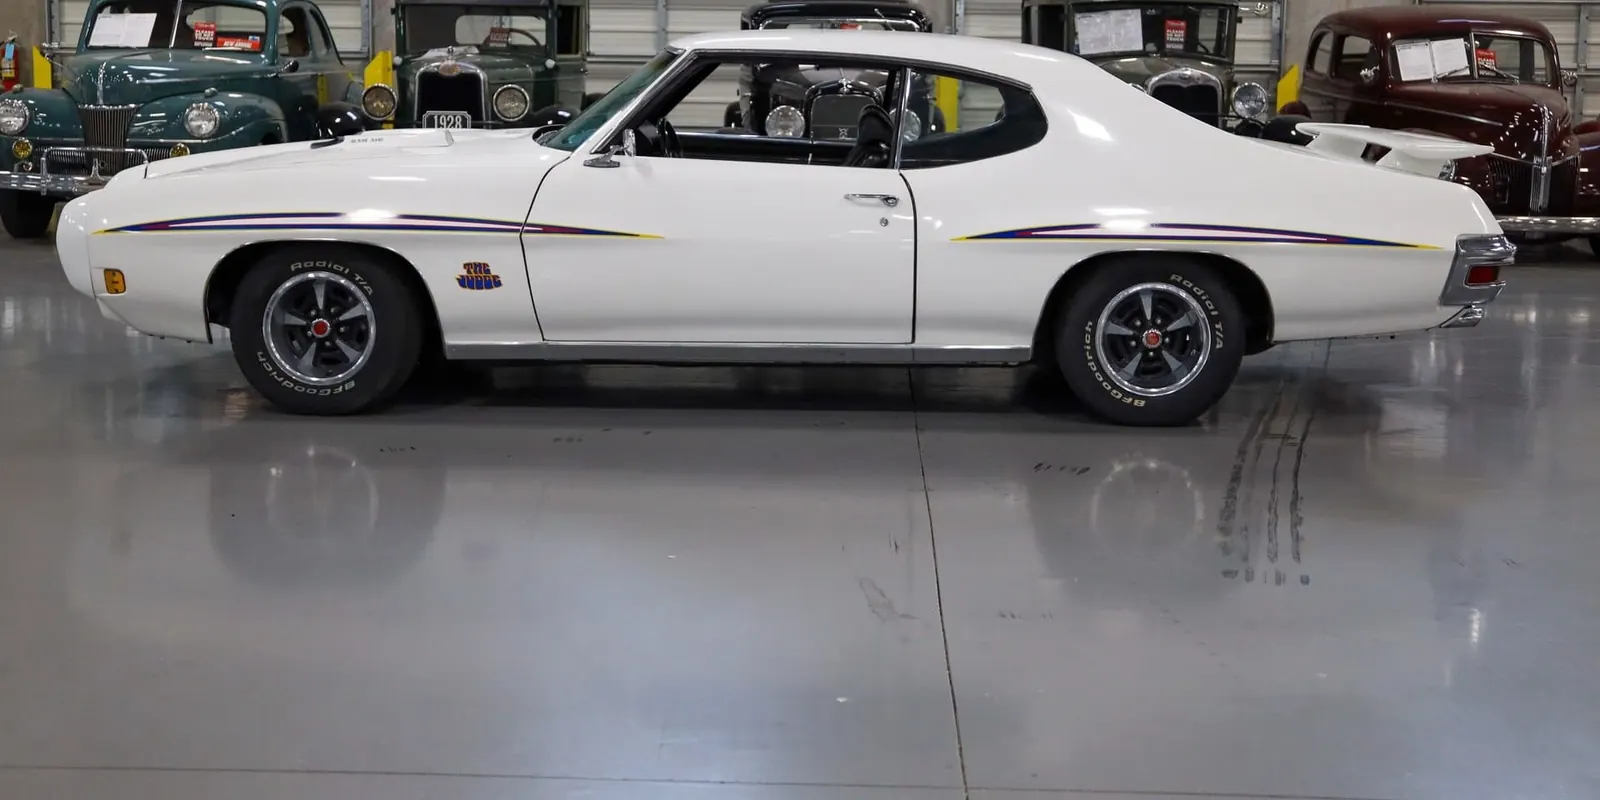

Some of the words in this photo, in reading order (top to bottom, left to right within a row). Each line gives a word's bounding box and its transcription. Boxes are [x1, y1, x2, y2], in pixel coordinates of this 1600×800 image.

[433, 114, 463, 129] 1928
[290, 260, 350, 275] Radial
[354, 273, 374, 296] T/A
[455, 274, 503, 291] JUDGE
[462, 261, 492, 275] THE
[1169, 273, 1220, 316] Radial
[1213, 321, 1225, 350] T/A
[255, 350, 356, 397] BFGoodrich
[1083, 320, 1146, 408] BFGoodrich
